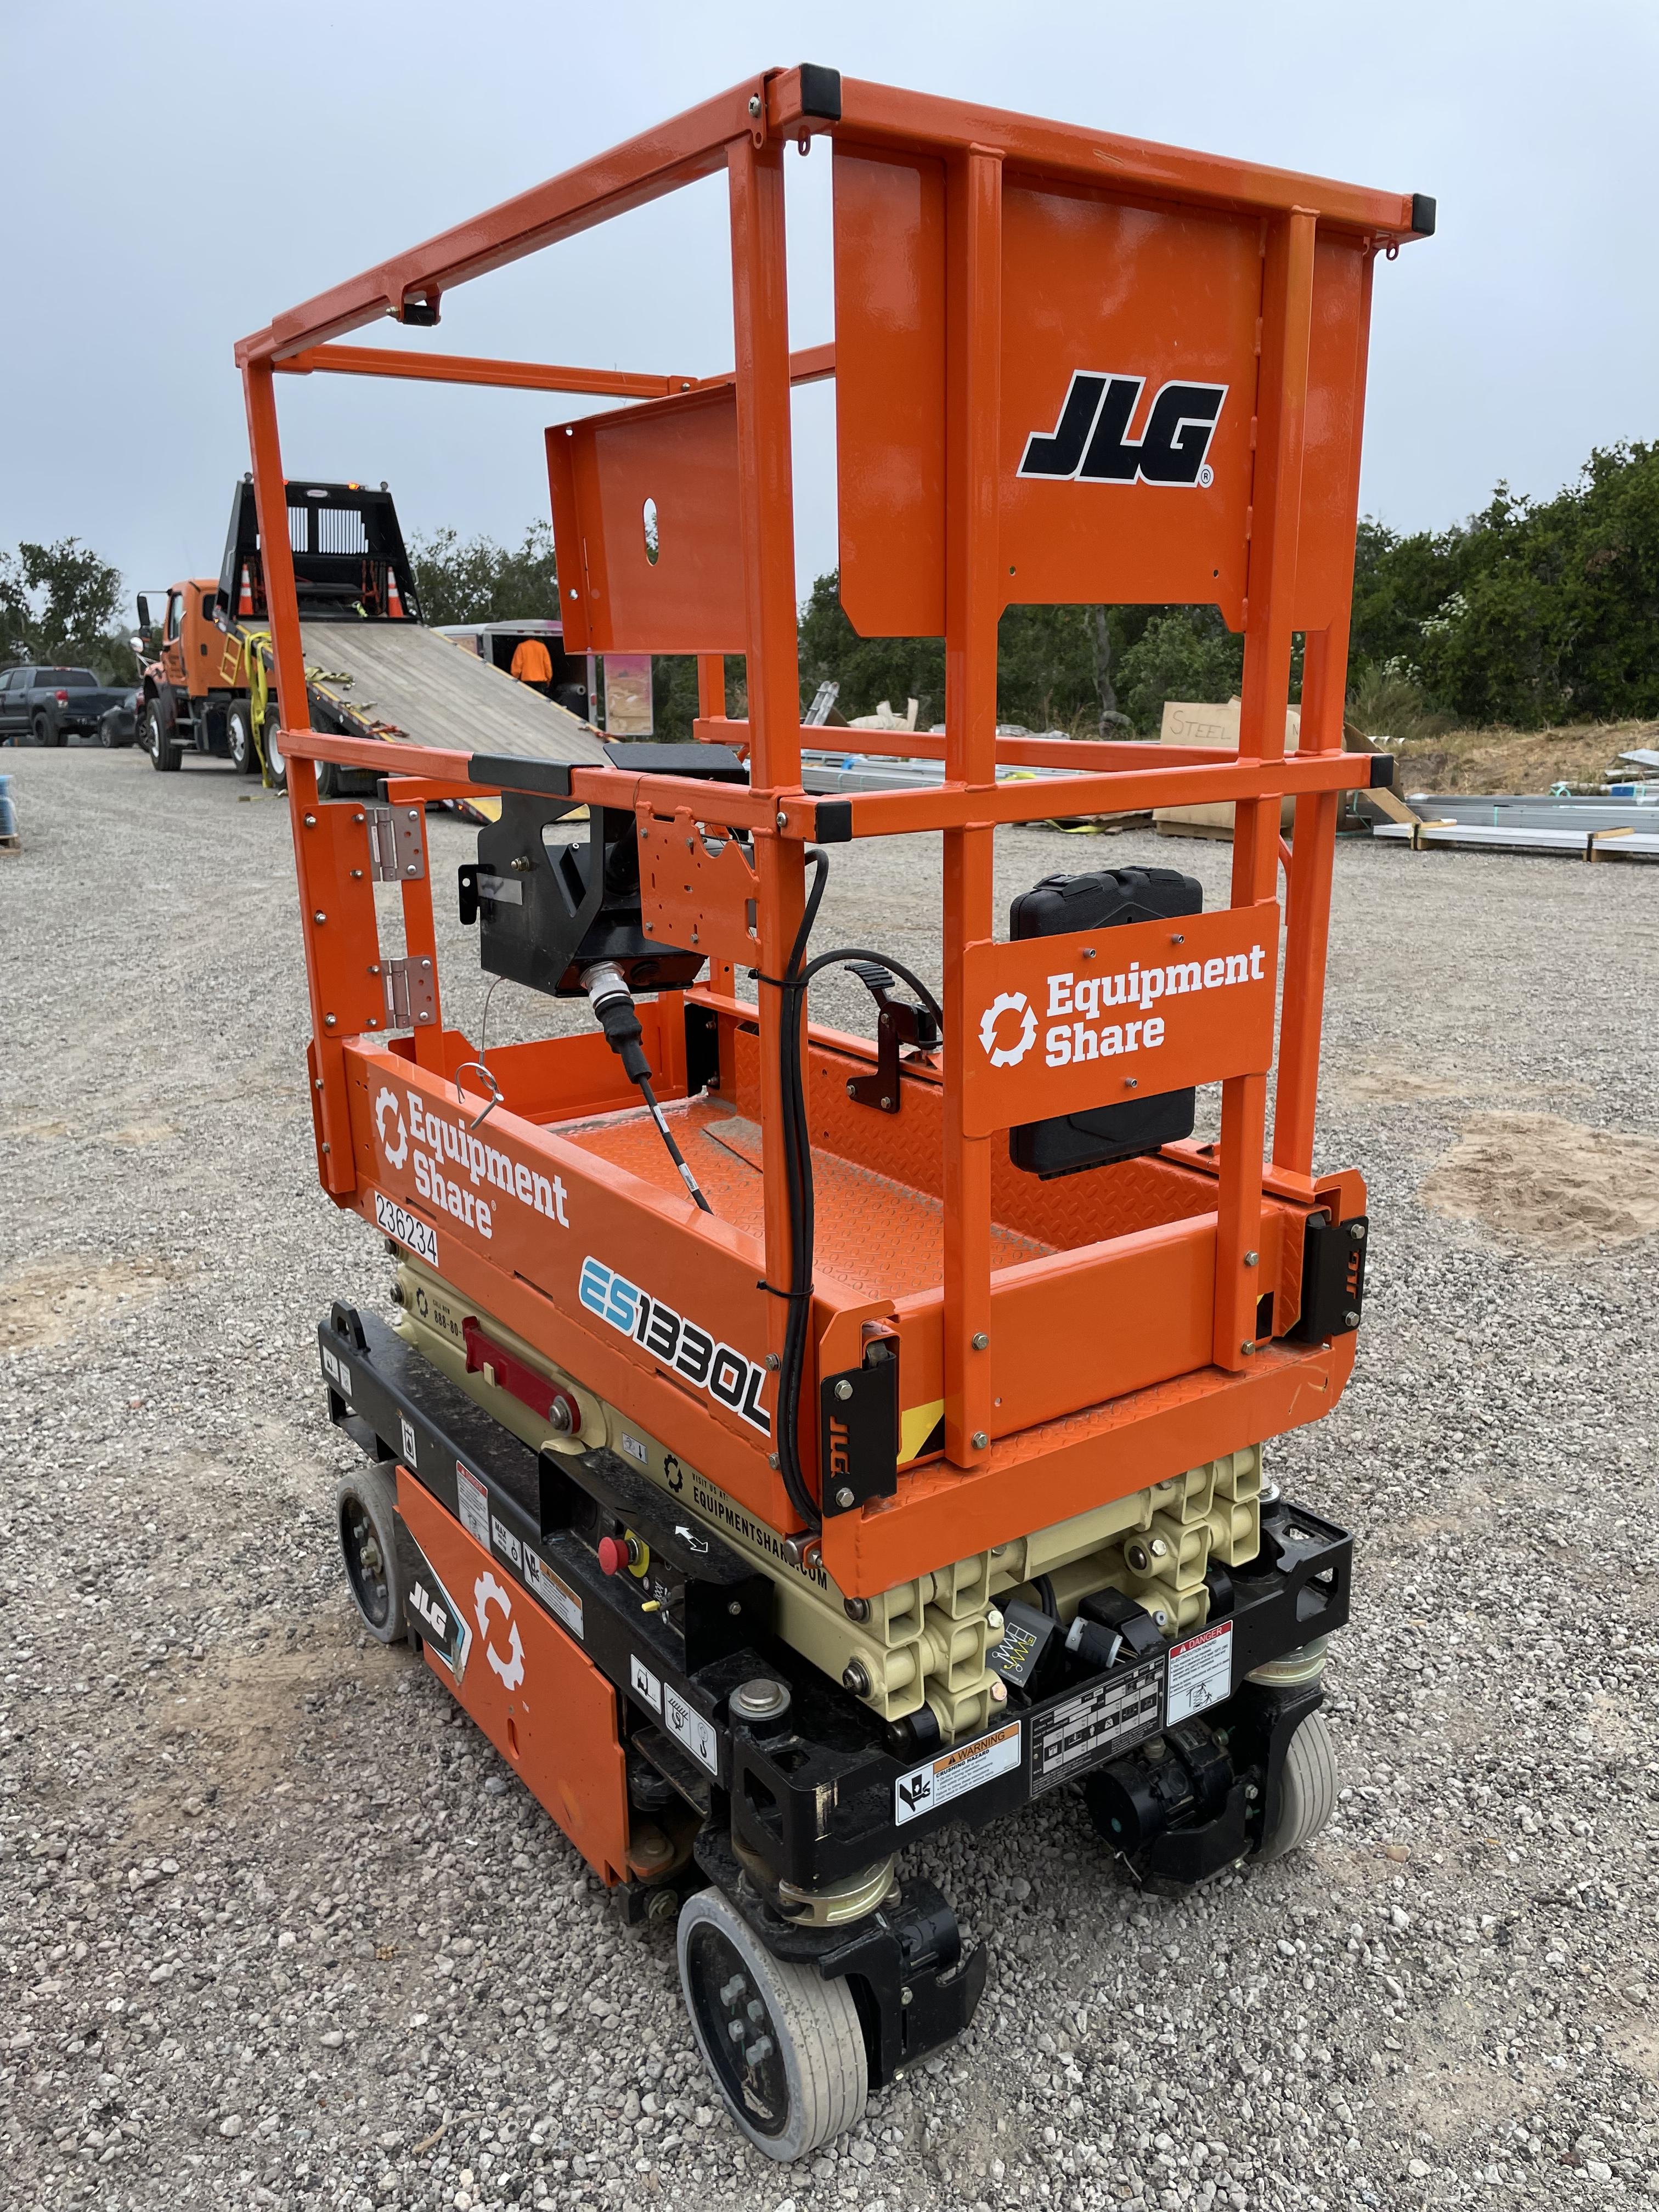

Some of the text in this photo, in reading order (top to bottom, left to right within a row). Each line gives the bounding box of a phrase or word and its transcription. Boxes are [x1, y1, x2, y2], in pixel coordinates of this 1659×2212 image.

[1016, 369, 1229, 488] JLG
[1170, 710, 1232, 740] STEEL
[1046, 945, 1265, 1020] Equipment
[1045, 1017, 1165, 1068] Share
[407, 1090, 569, 1229] Equipment
[413, 1149, 493, 1239] Share
[376, 1194, 437, 1263] 236234
[1346, 1251, 1359, 1300] JLG
[432, 1299, 441, 1311] CALL
[434, 1310, 465, 1340] 888-80-
[579, 1257, 771, 1436] ES1330L
[830, 1415, 850, 1475] JLG
[692, 1472, 729, 1502] VISIT US AT:
[495, 1521, 506, 1538] MAX
[693, 1485, 827, 1591] EQUIPMENTSHAR.COM
[409, 1581, 447, 1639] JLG
[1189, 1627, 1223, 1648] DANGER
[936, 1749, 990, 1778] CRUSHING HAZARD
[958, 1731, 1005, 1759] WARNING
